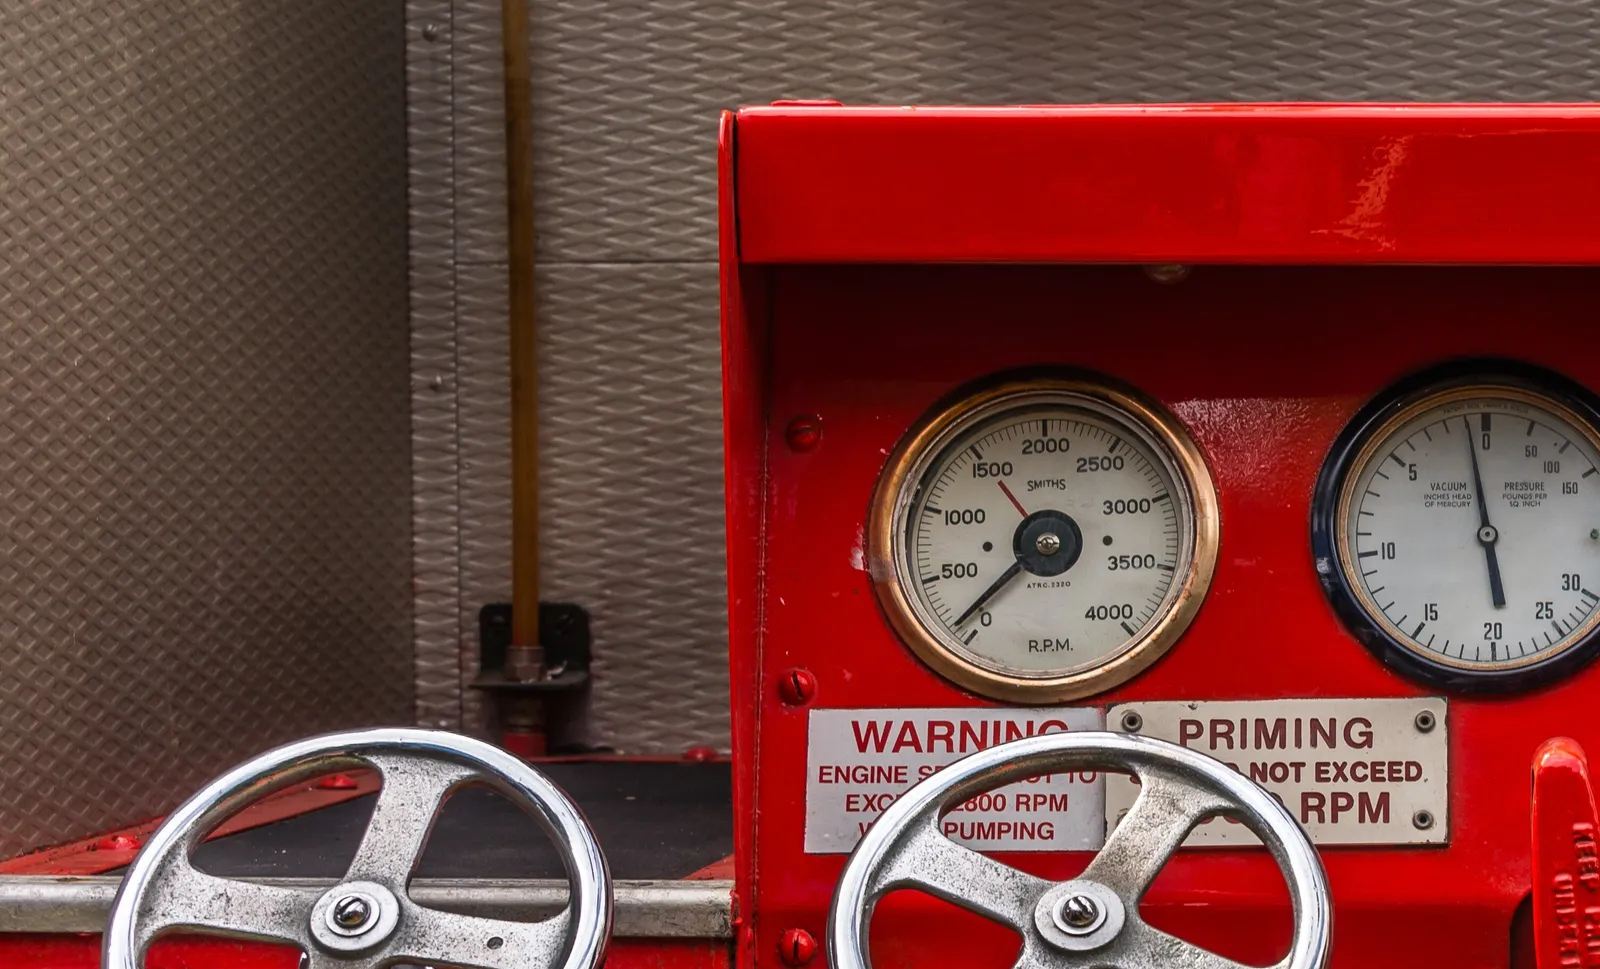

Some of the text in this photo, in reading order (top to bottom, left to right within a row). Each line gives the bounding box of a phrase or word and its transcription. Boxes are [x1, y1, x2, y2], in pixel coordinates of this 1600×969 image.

[1022, 438, 1070, 455] 2000
[1482, 433, 1490, 450] 0
[1525, 445, 1538, 458] 50
[972, 462, 1013, 479] 1500
[1076, 456, 1124, 473] 2500
[1408, 463, 1418, 482] 5
[1543, 461, 1560, 474] 100
[1027, 479, 1066, 491] SMITHS
[1430, 482, 1467, 491] VACUUM
[1504, 482, 1545, 491] PRESSURE
[1562, 481, 1578, 495] 150
[1103, 498, 1151, 515] 3000
[1522, 500, 1540, 508] INCH
[945, 509, 986, 526] 1000
[1381, 543, 1395, 560] 10
[941, 563, 978, 579] 500
[1107, 554, 1155, 571] 3500
[1562, 574, 1581, 591] 30
[980, 611, 992, 627] 0
[1085, 604, 1133, 621] 4000
[1424, 604, 1439, 621] 15
[1535, 602, 1554, 620] 25
[1484, 623, 1503, 640] 20
[1028, 638, 1074, 653] R.P.M.
[1179, 717, 1374, 750] PRIMING
[819, 765, 908, 784] ENGINE
[1250, 761, 1305, 783] NOT
[1015, 794, 1068, 812] RPM
[1301, 791, 1390, 824] RPM
[944, 822, 1054, 841] PUMPING
